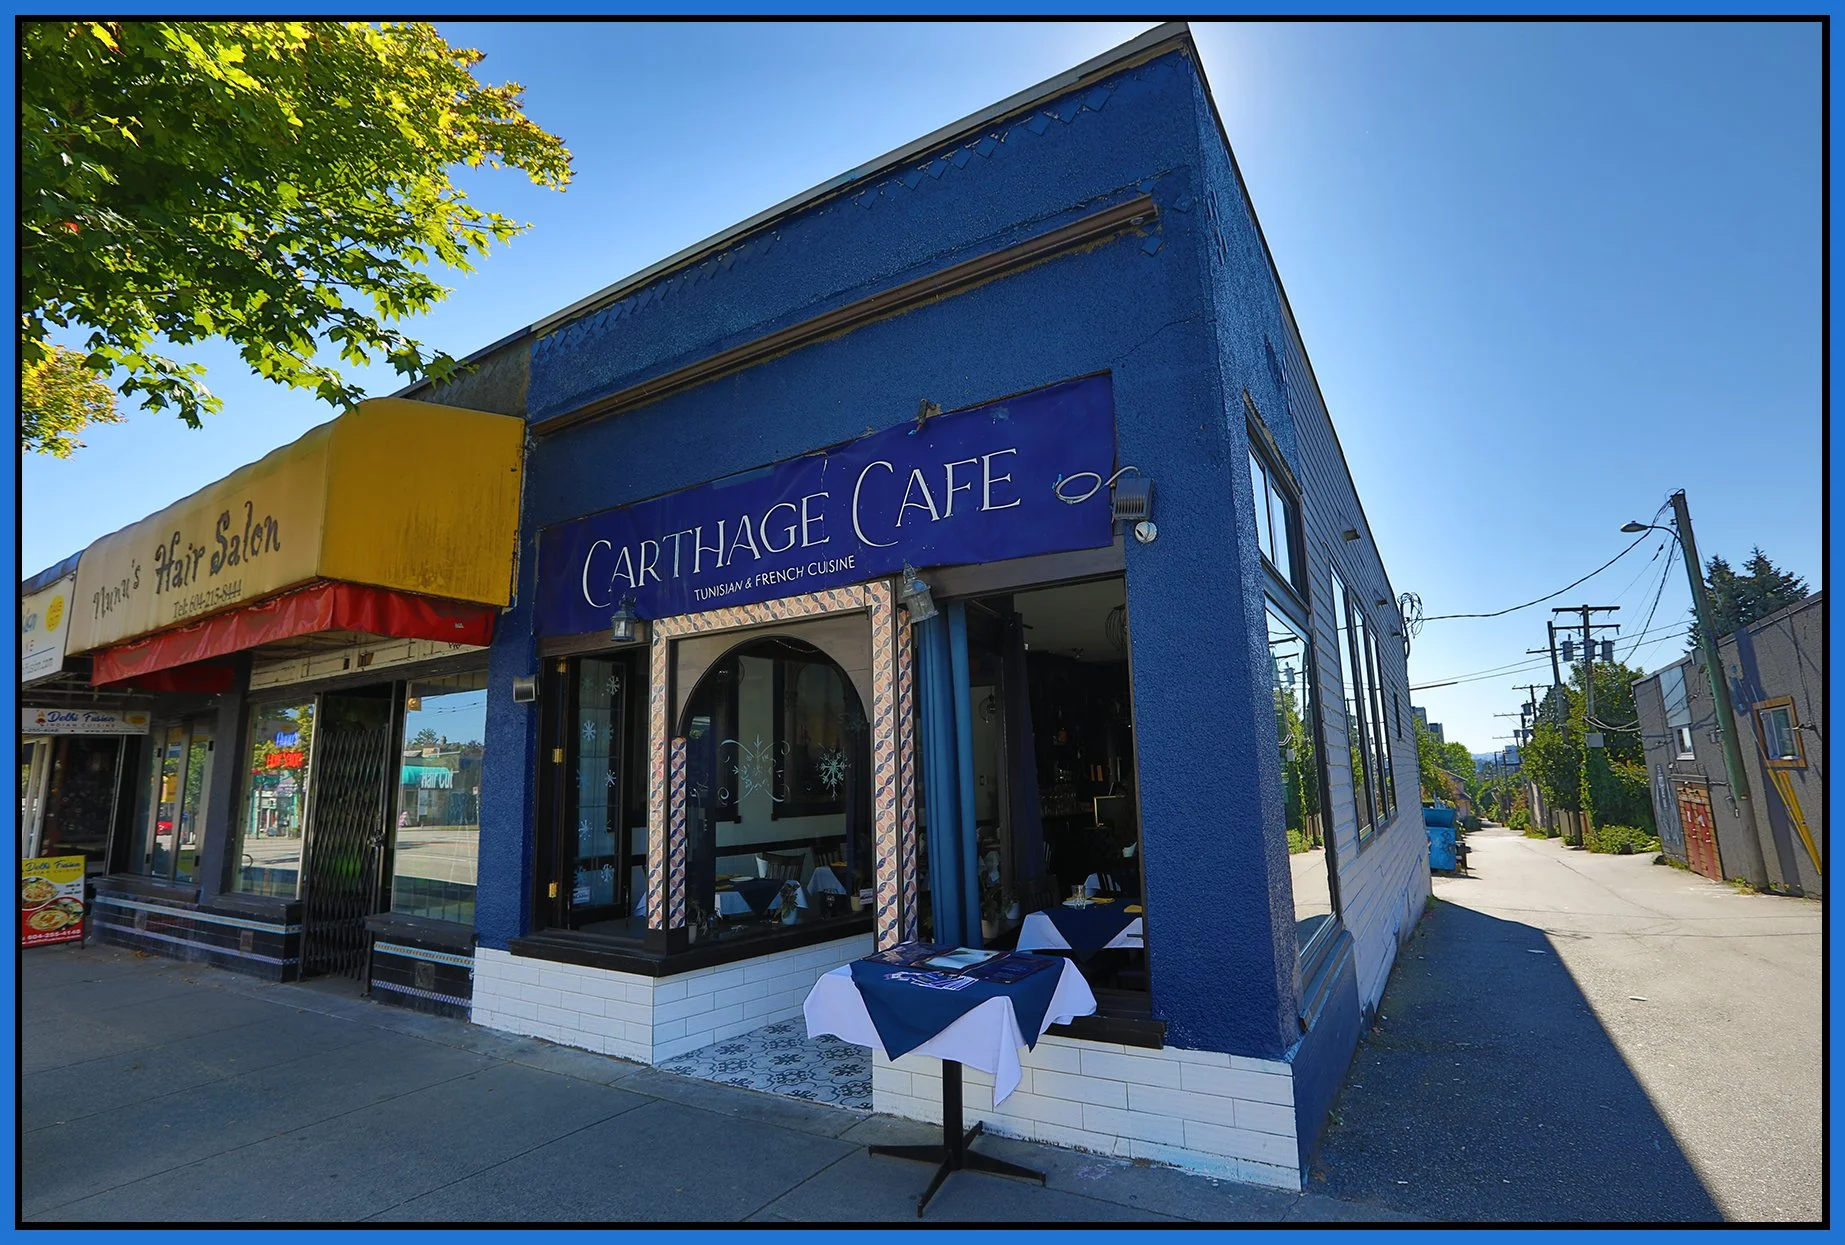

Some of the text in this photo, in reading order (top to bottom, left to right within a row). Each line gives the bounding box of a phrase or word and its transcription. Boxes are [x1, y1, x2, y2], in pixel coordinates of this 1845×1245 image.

[582, 448, 1021, 609] CARTHAGE CAFE
[93, 559, 141, 620] Nunu's
[155, 531, 205, 595] Hair
[209, 500, 280, 577] Salon
[694, 555, 856, 601] TUNISIAN & FRENCH CUISINE
[47, 710, 79, 723] Delhi
[82, 711, 116, 723] Fusion
[439, 768, 453, 789] Cut
